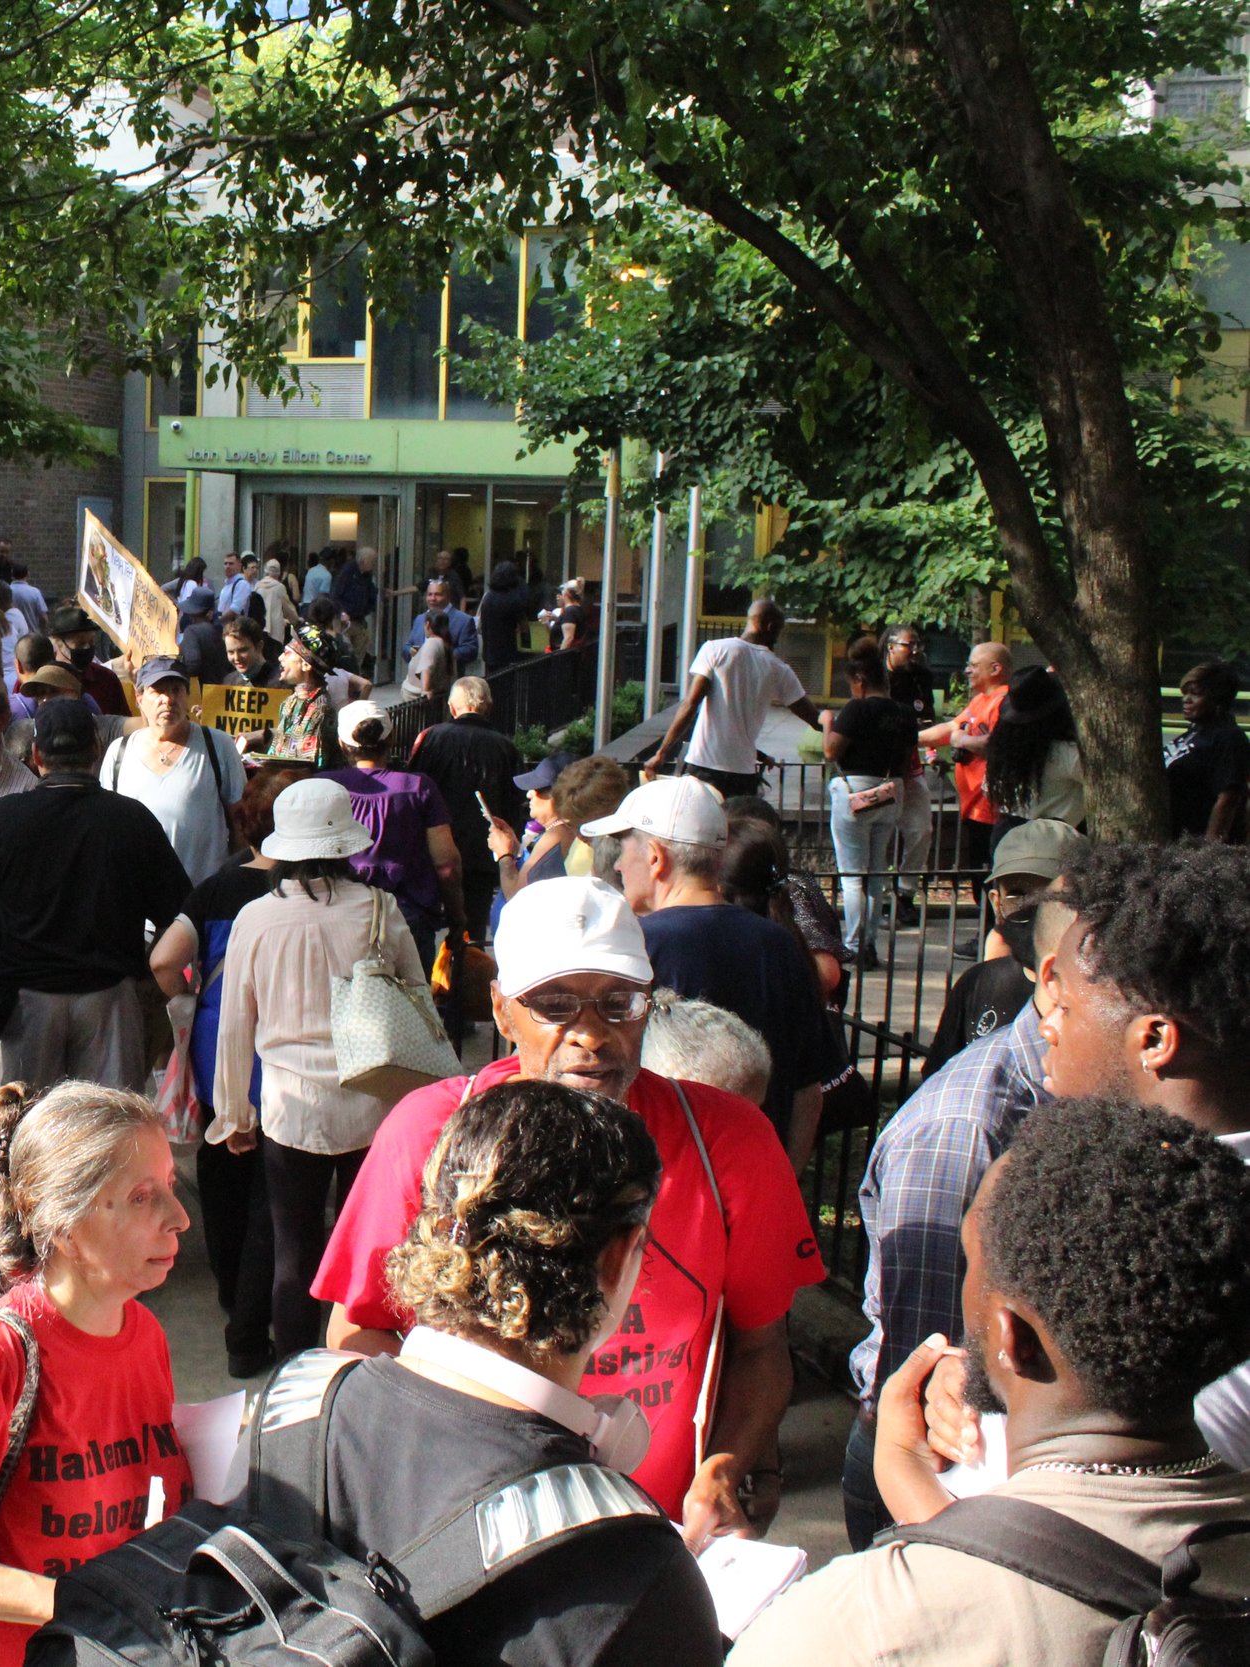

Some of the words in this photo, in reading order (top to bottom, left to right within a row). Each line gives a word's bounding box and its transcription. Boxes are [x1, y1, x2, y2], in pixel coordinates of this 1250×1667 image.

[186, 448, 219, 462] John
[225, 448, 277, 465] Lovejoy
[282, 448, 319, 464] Elliott
[326, 450, 372, 464] Center
[225, 689, 269, 714] KEEP
